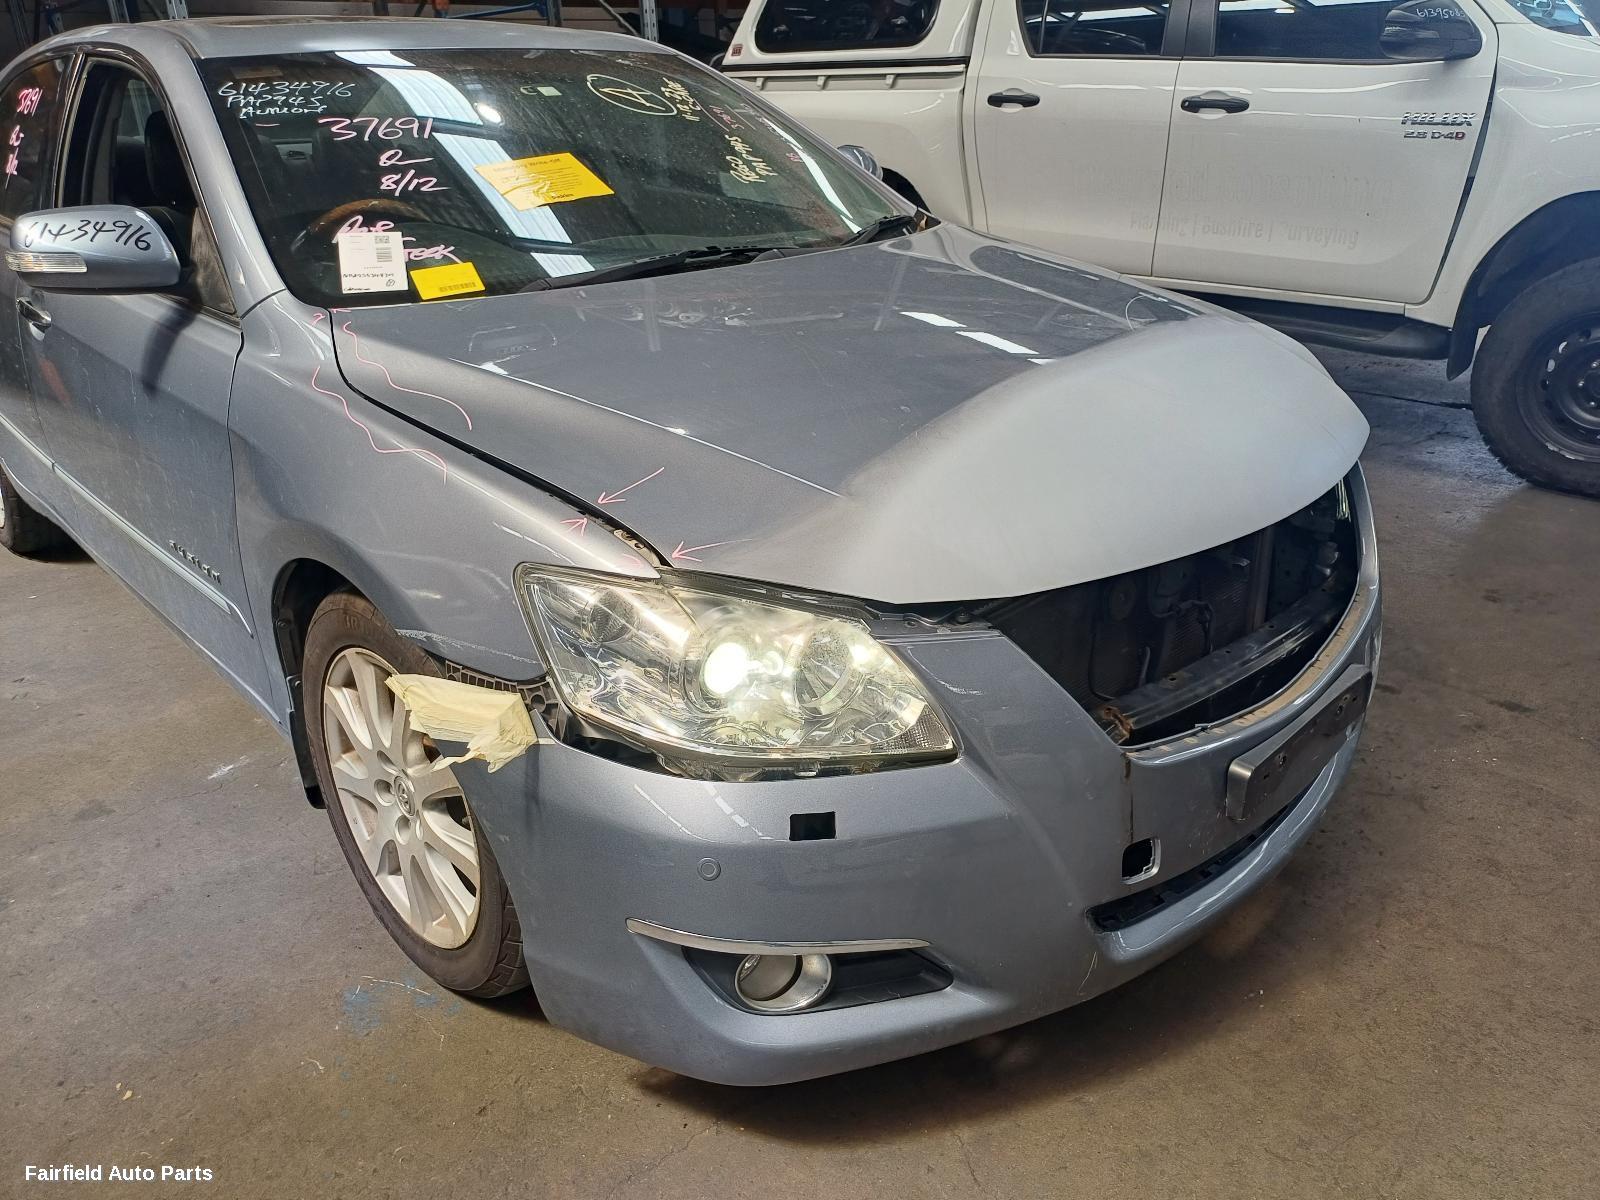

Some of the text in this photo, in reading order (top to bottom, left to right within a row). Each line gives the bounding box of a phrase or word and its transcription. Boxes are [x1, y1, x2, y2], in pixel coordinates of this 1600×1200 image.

[218, 80, 355, 97] 61434916
[318, 117, 434, 141] 37691
[380, 169, 452, 197] 8/12
